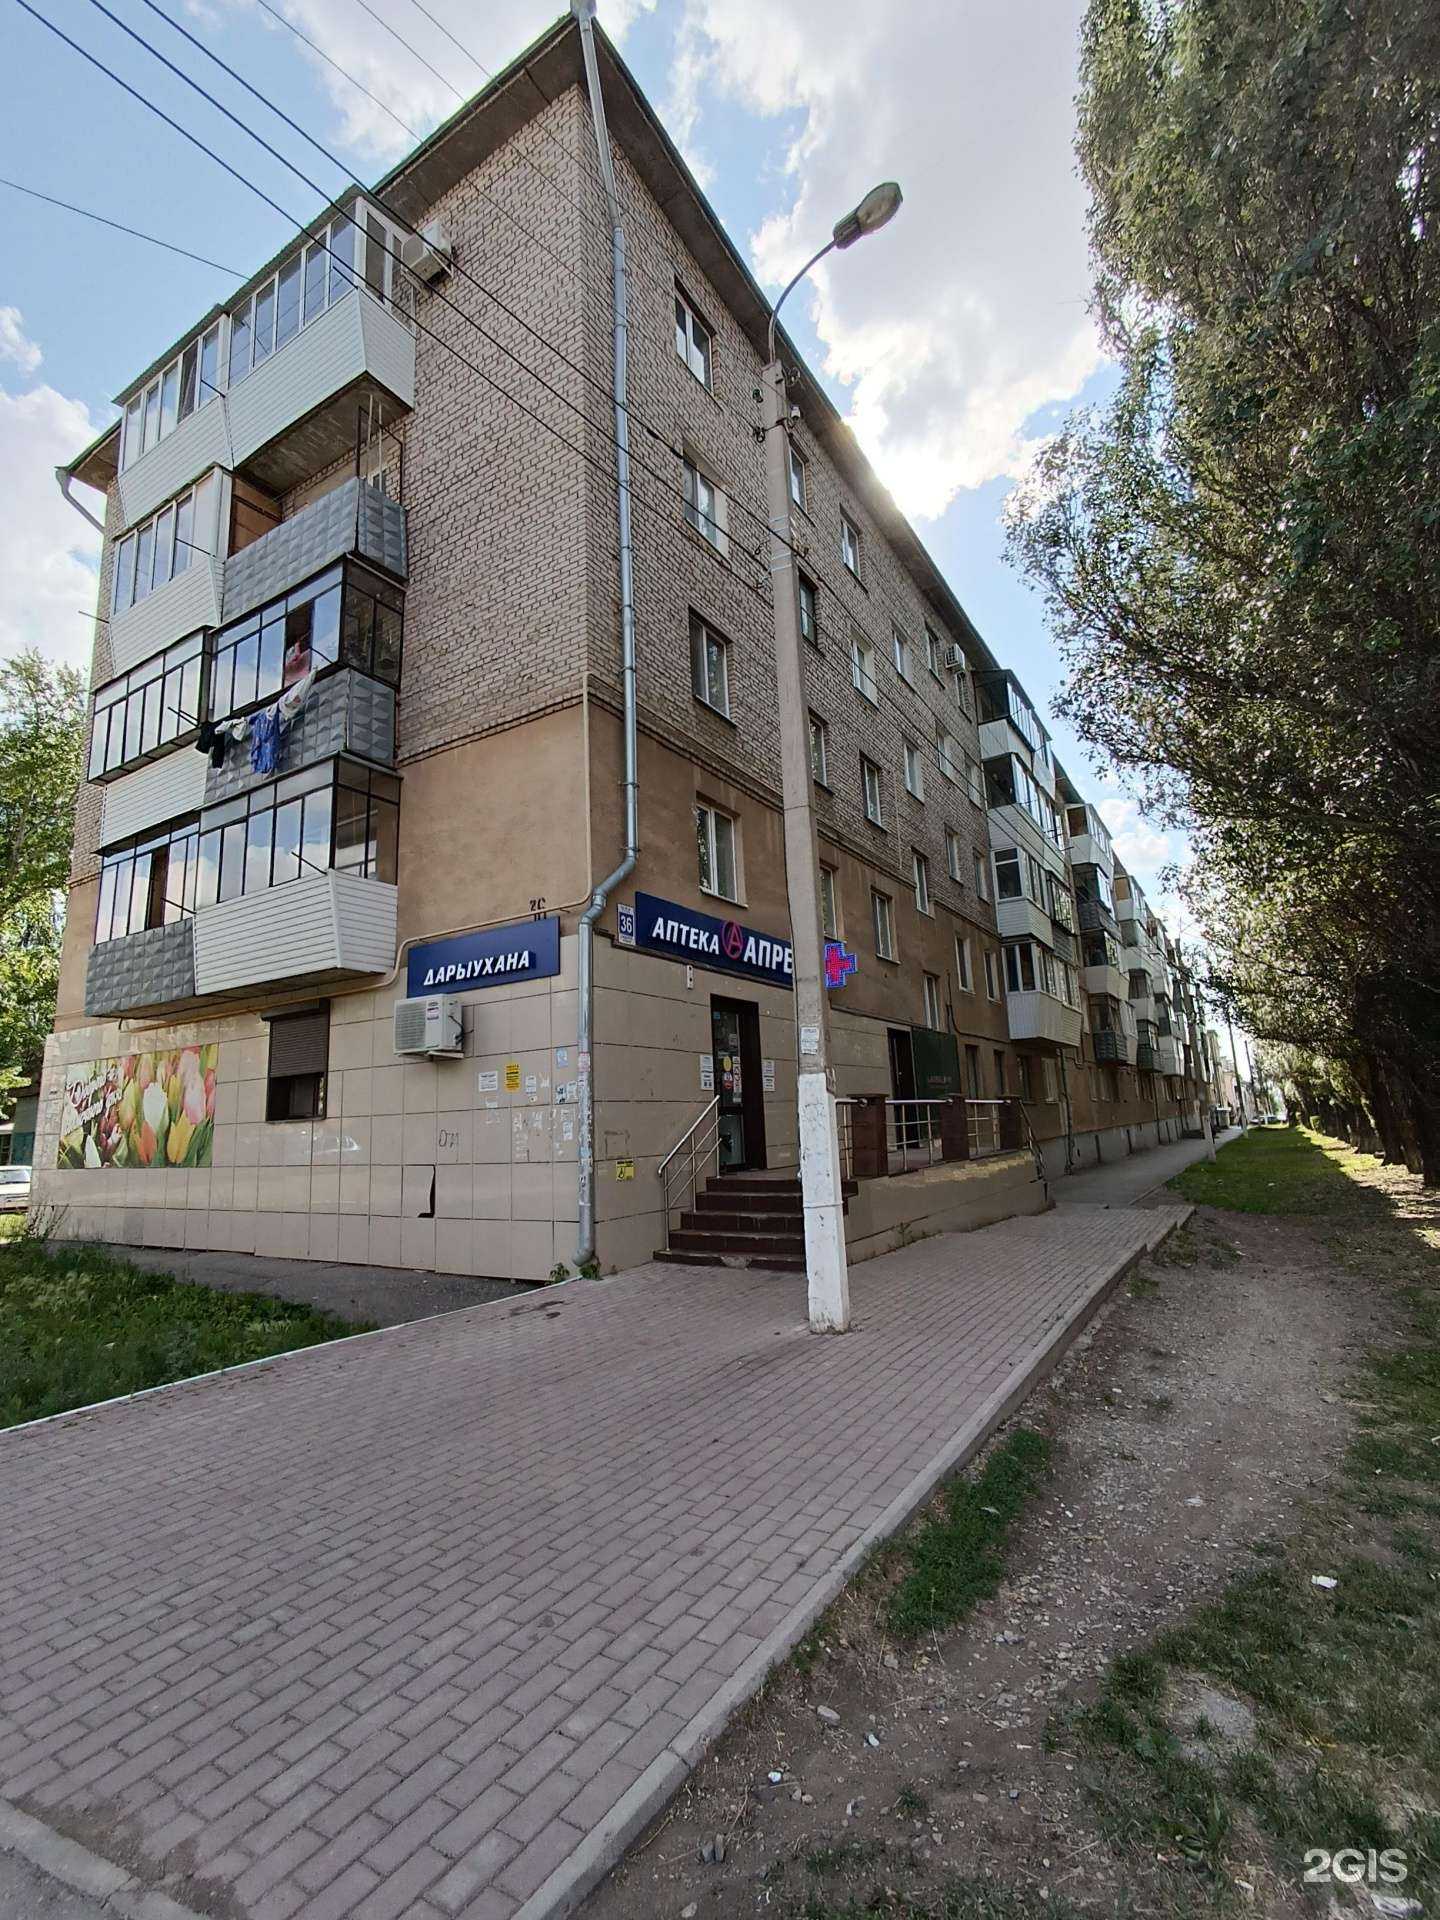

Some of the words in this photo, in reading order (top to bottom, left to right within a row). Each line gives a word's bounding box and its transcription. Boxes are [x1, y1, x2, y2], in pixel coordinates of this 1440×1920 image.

[620, 915, 633, 933] 36
[652, 917, 720, 955] АПТЕКА
[743, 936, 794, 974] АПРЕ
[423, 950, 530, 986] ДАРЫУХАНА
